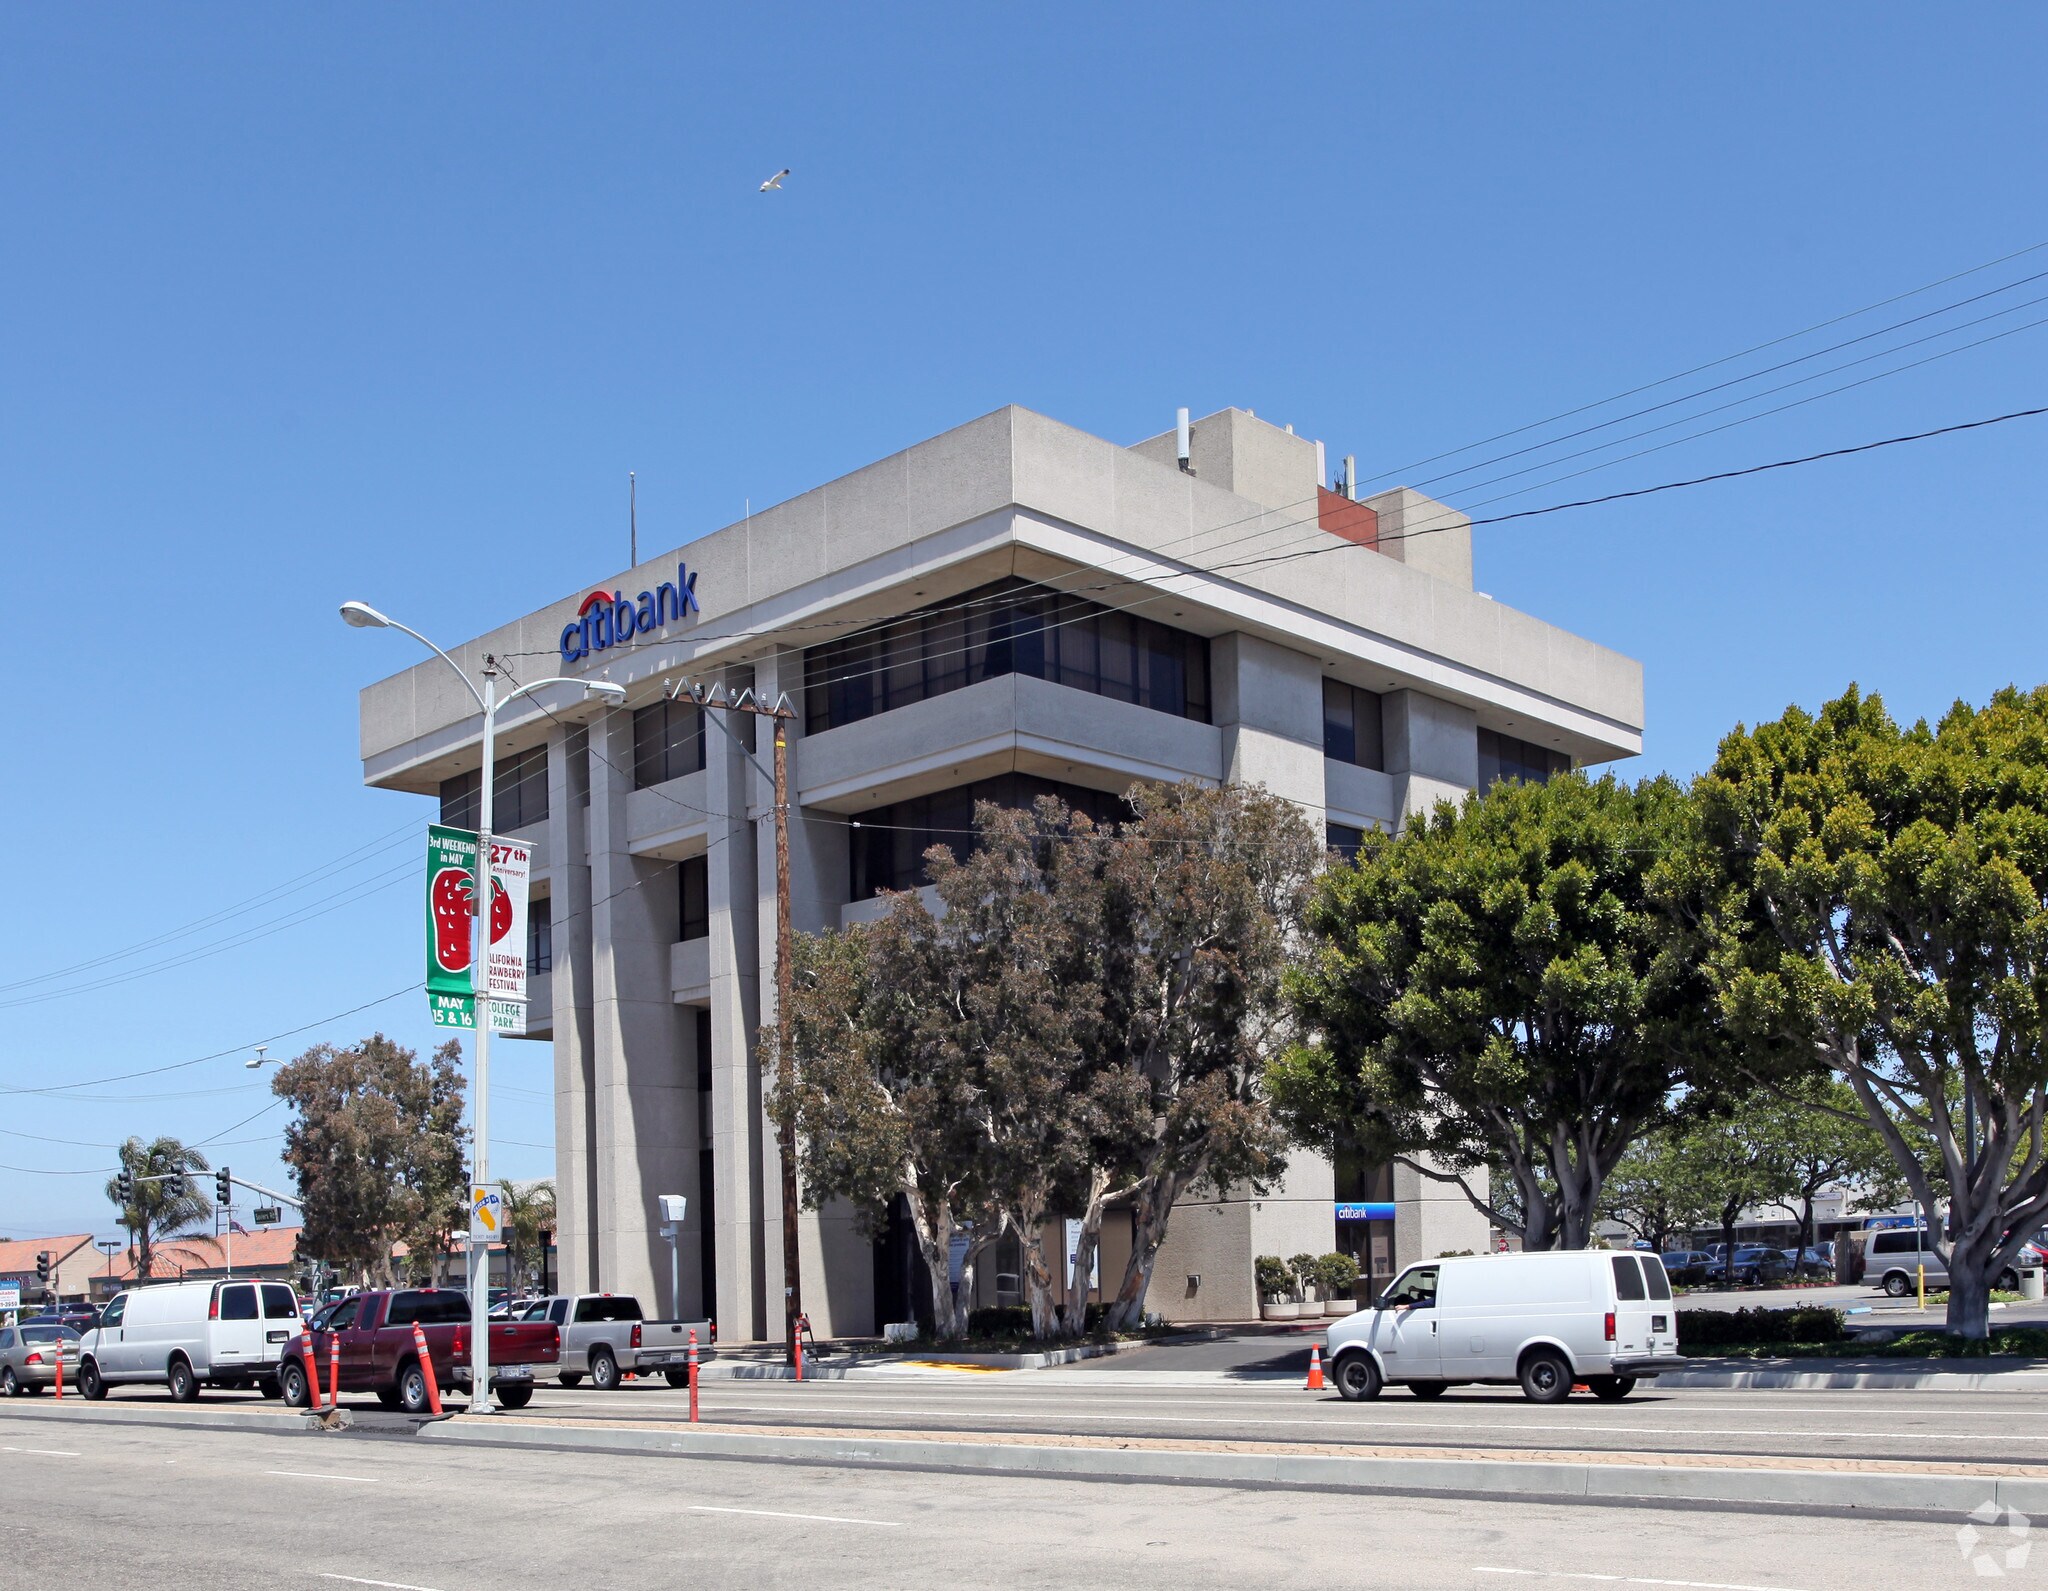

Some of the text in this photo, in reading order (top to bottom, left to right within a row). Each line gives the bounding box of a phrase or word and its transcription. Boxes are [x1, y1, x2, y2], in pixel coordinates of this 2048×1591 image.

[560, 563, 699, 662] citibank
[429, 835, 476, 855] 3rd WEEKEND
[440, 851, 464, 865] in MAY
[490, 844, 527, 864] 27th
[489, 953, 522, 967] ALIFORNIA
[489, 966, 525, 980] RAWBERRY
[489, 978, 518, 992] FESTIVAL
[438, 995, 464, 1010] MAY
[432, 1009, 473, 1026] 15 & 16
[493, 1015, 514, 1028] PARK
[1338, 1206, 1367, 1219] citibank
